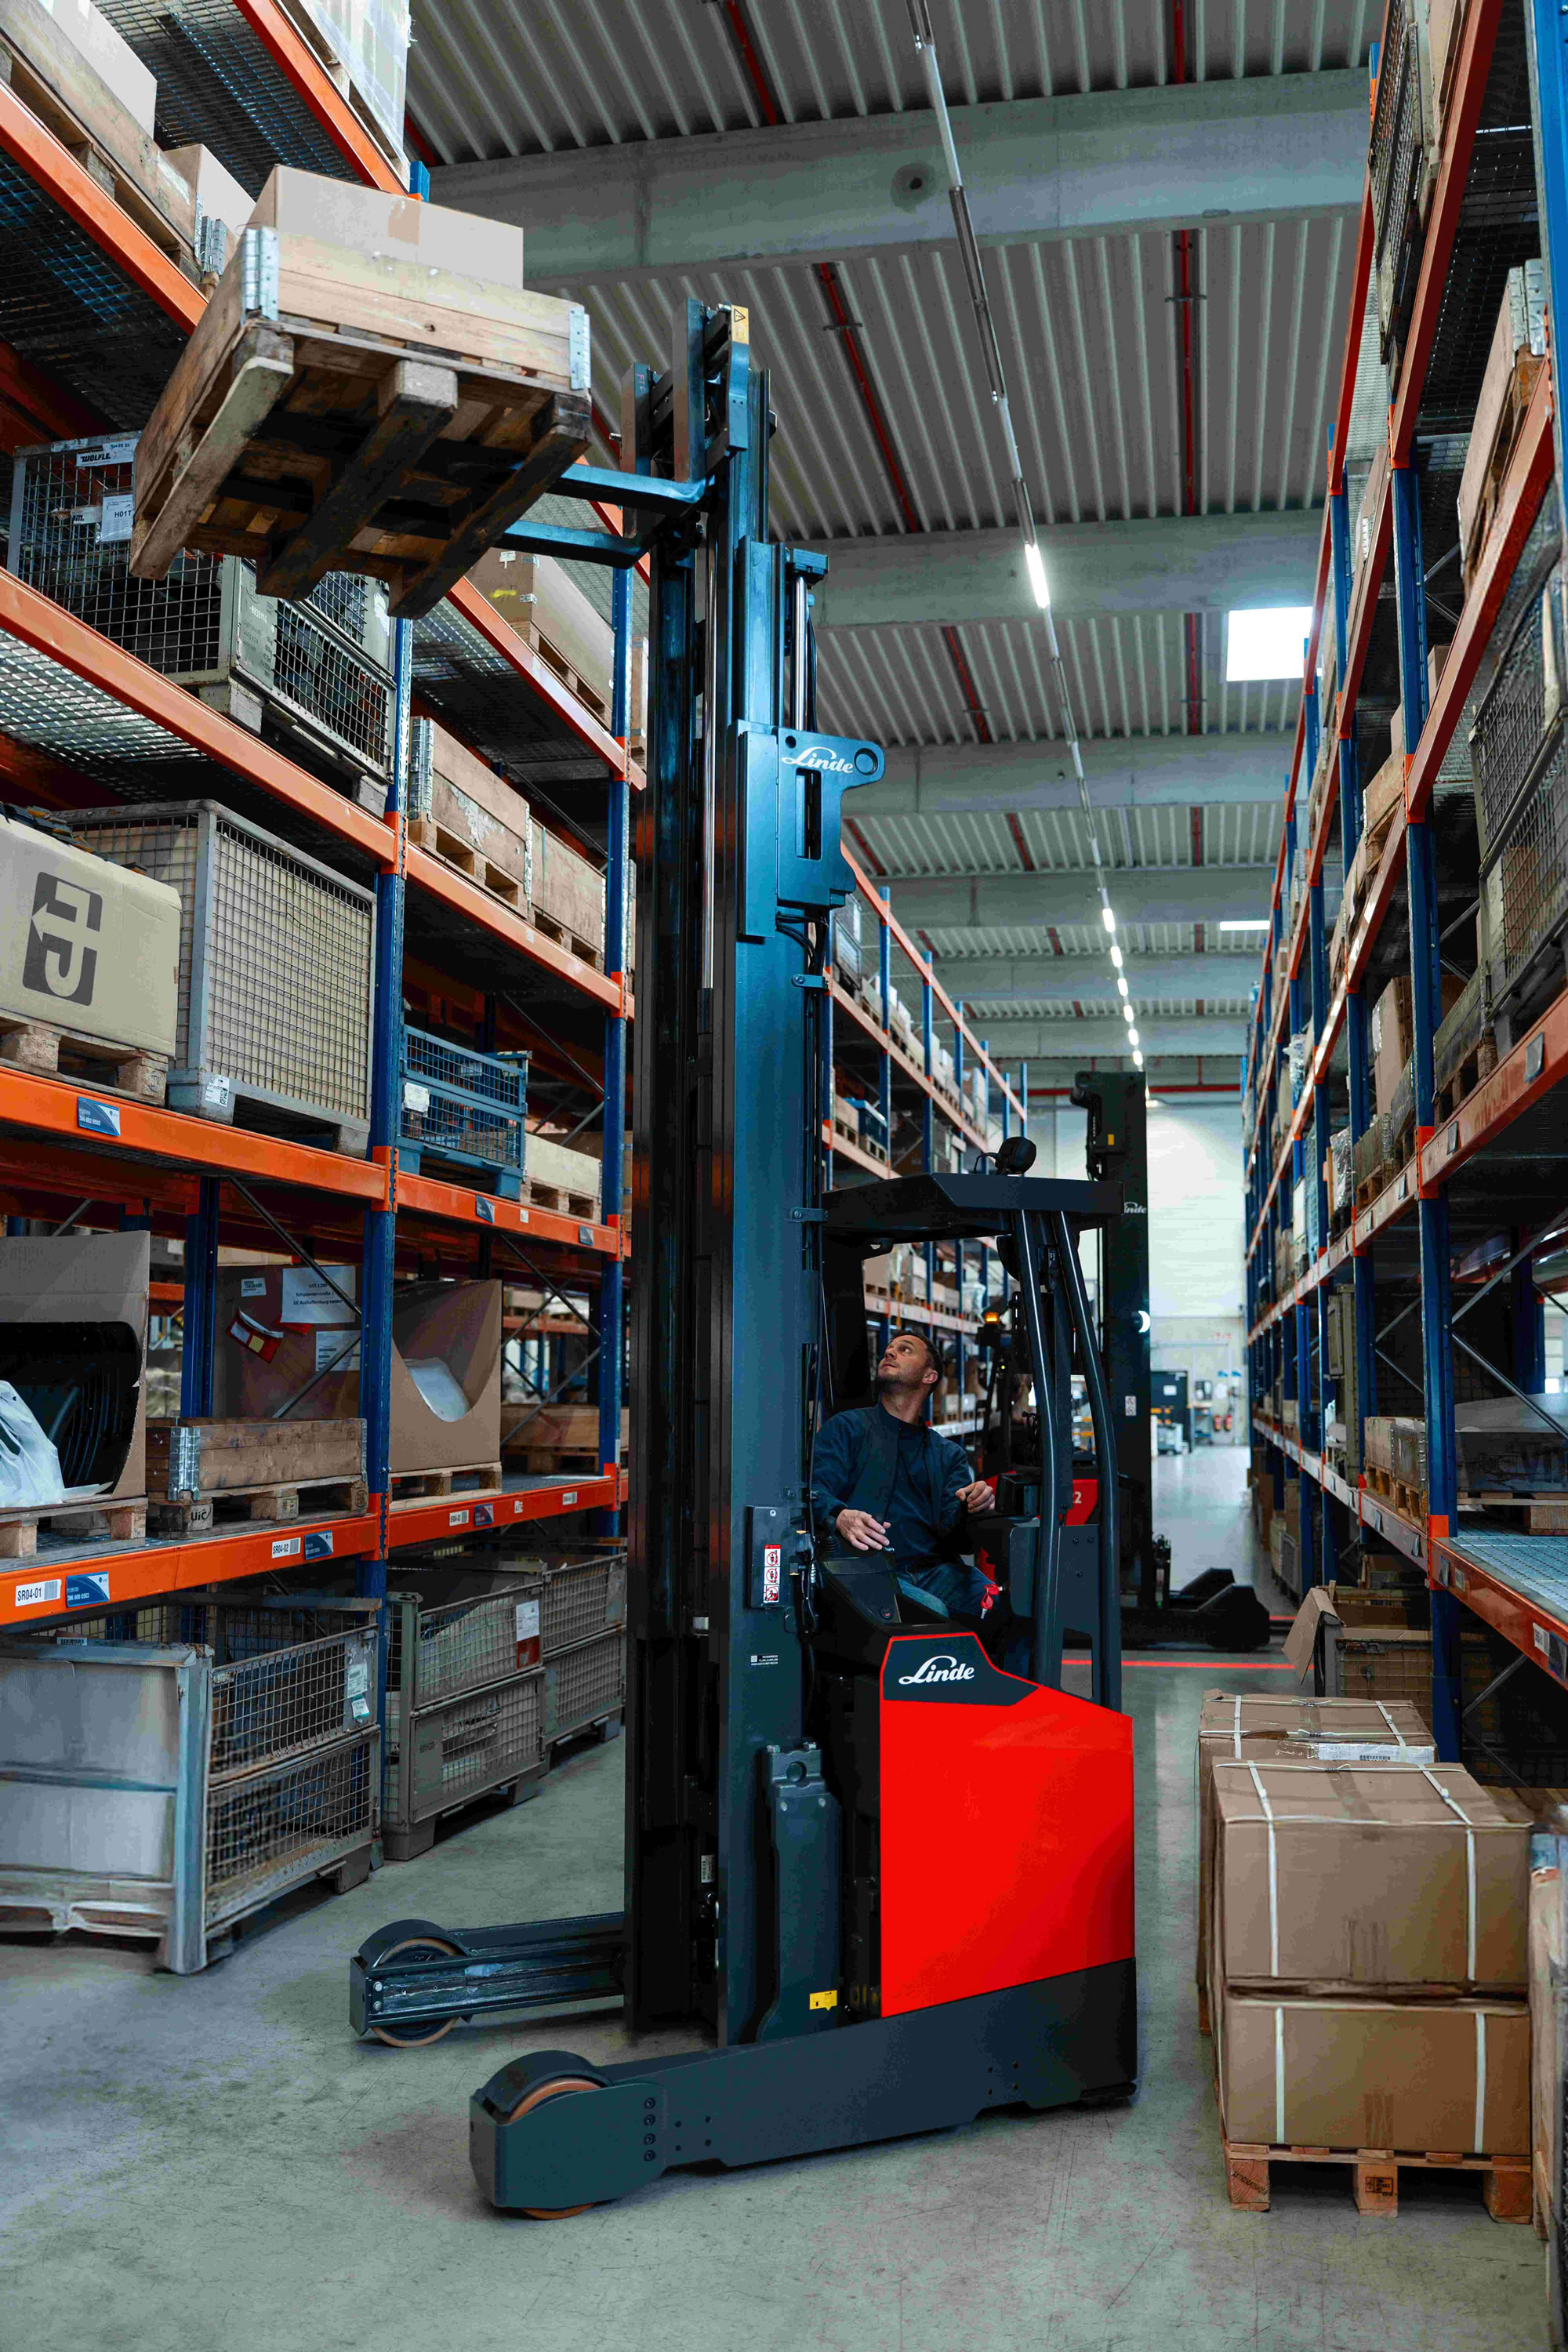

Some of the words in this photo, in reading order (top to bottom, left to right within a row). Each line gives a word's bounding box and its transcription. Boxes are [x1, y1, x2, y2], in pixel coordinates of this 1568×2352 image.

[781, 746, 853, 773] Linde
[17, 1588, 42, 1602] SR04-01
[898, 1655, 975, 1685] Linde
